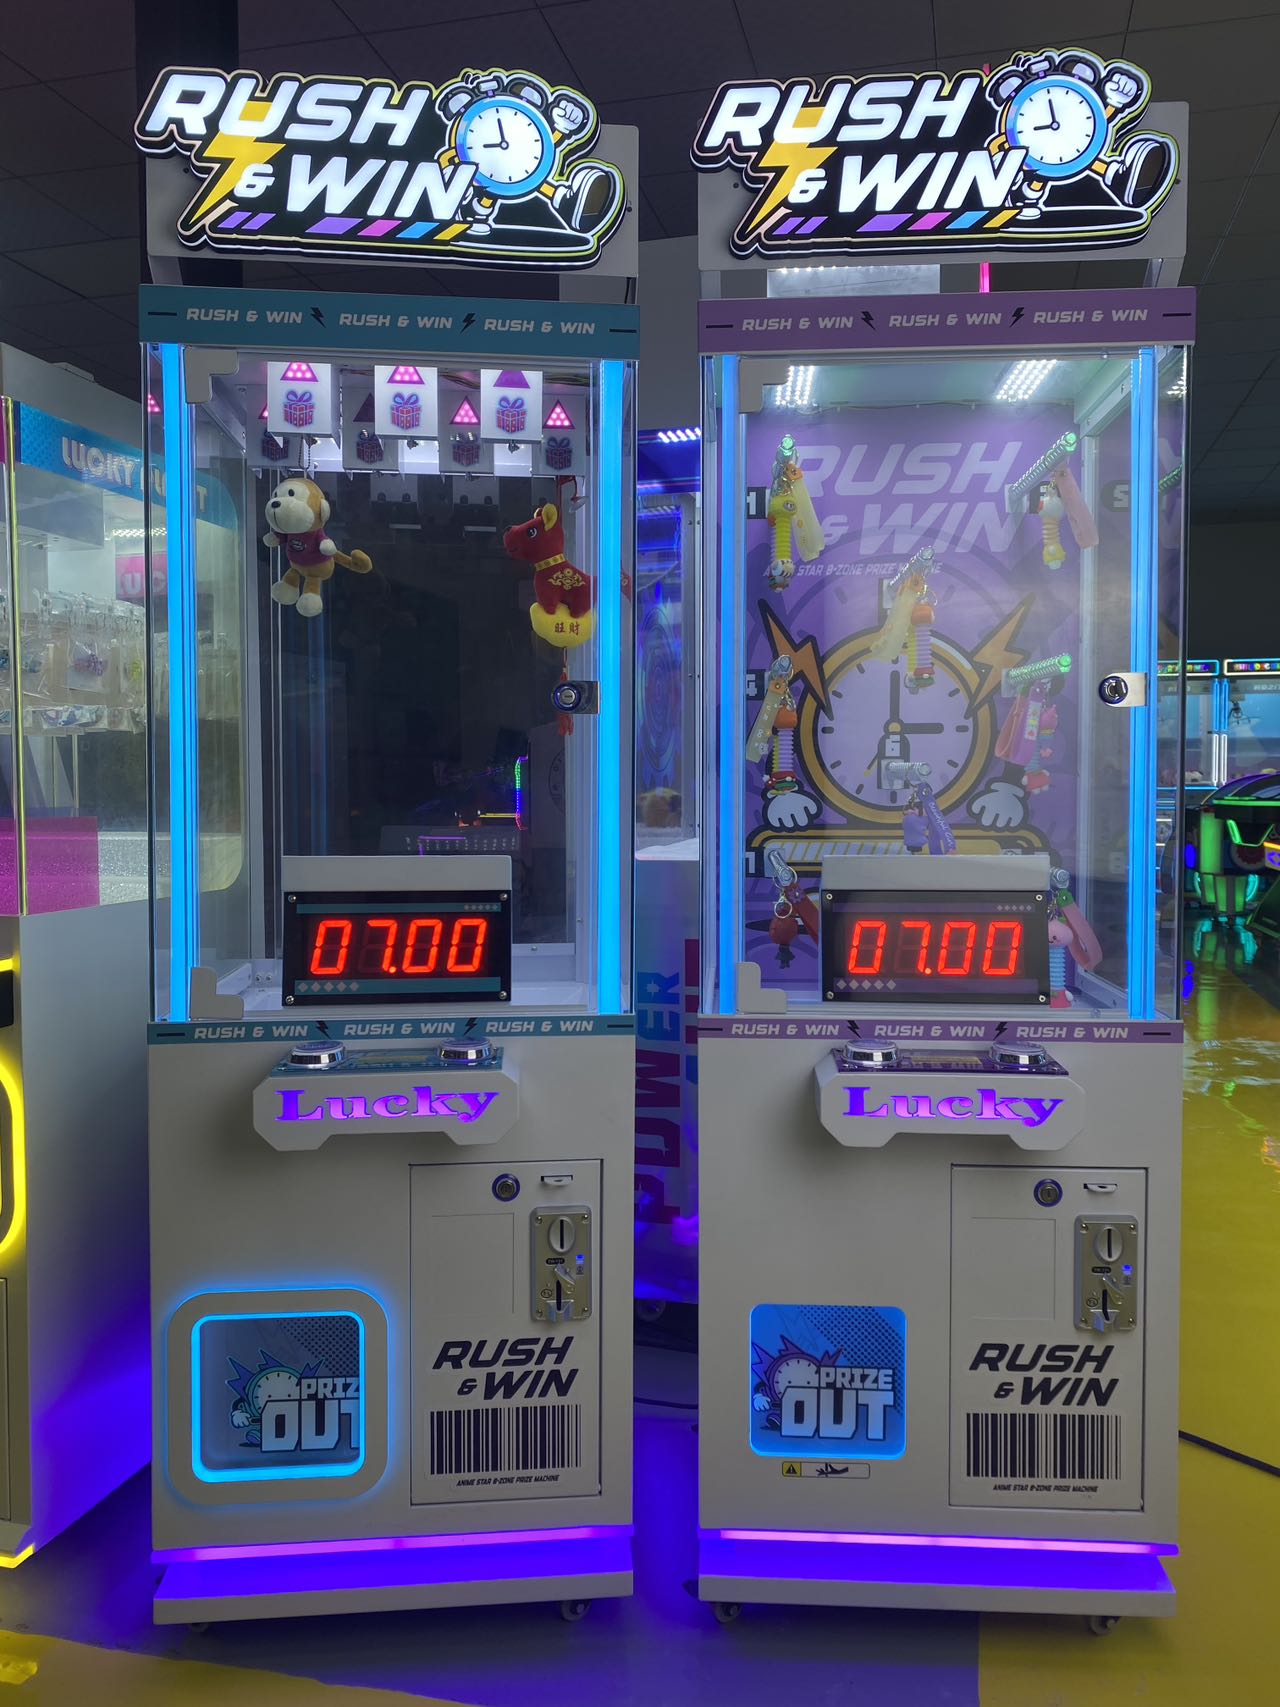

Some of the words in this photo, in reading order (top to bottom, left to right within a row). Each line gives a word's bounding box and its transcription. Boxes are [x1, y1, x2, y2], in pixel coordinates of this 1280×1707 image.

[145, 73, 430, 146] RUSH
[703, 76, 981, 149] RUSH
[232, 162, 276, 200] &
[286, 154, 480, 221] WIN
[787, 168, 829, 204] &
[837, 145, 1030, 214] WIN
[186, 308, 240, 322] RUSH
[246, 310, 259, 323] &
[266, 310, 303, 324] WIN
[339, 313, 391, 327] RUSH
[397, 315, 410, 328] &
[416, 316, 453, 329] WIN
[484, 318, 535, 332] RUSH
[541, 321, 553, 333] &
[560, 321, 596, 335] WIN
[742, 318, 793, 331] RUSH
[798, 317, 811, 329] &
[817, 316, 854, 329] WIN
[888, 314, 940, 328] RUSH
[946, 314, 959, 326] &
[965, 313, 1002, 326] WIN
[1033, 310, 1085, 324] RUSH
[1091, 310, 1104, 322] &
[1111, 309, 1148, 322] WIN
[794, 440, 1024, 498] RUSH
[860, 501, 1023, 556] WIN
[797, 564, 824, 577] STAR
[864, 562, 897, 575] PRIZE
[309, 917, 488, 976] 07.00
[847, 919, 1024, 976] 07.00
[194, 1027, 246, 1039] RUSH
[252, 1026, 264, 1038] &
[272, 1025, 309, 1037] WIN
[343, 1023, 395, 1036] RUSH
[401, 1023, 413, 1034] &
[420, 1022, 456, 1034] WIN
[485, 1020, 535, 1033] RUSH
[541, 1020, 553, 1032] &
[559, 1020, 594, 1032] WIN
[731, 1023, 780, 1035] RUSH
[786, 1023, 798, 1035] &
[805, 1024, 840, 1036] WIN
[874, 1024, 924, 1037] RUSH
[930, 1025, 942, 1037] &
[949, 1025, 985, 1037] WIN
[1016, 1026, 1067, 1038] RUSH
[1073, 1026, 1086, 1038] &
[1093, 1027, 1129, 1039] WIN
[275, 1085, 500, 1123] Lucky
[842, 1086, 1066, 1128] Lucky
[432, 1336, 574, 1370] RUSH
[968, 1343, 1115, 1373] RUSH
[301, 1377, 360, 1399] PRIZ
[457, 1378, 478, 1396] &
[483, 1368, 579, 1400] WIN
[820, 1367, 893, 1390] PRIZE
[993, 1381, 1015, 1399] &
[1020, 1376, 1120, 1407] WIN
[780, 1386, 895, 1440] OUT
[456, 1479, 476, 1487] ANIME
[476, 1478, 492, 1486] STAR
[516, 1476, 534, 1484] PRIZE
[534, 1474, 560, 1482] MACHINE
[1072, 1485, 1099, 1493] MACHINE
